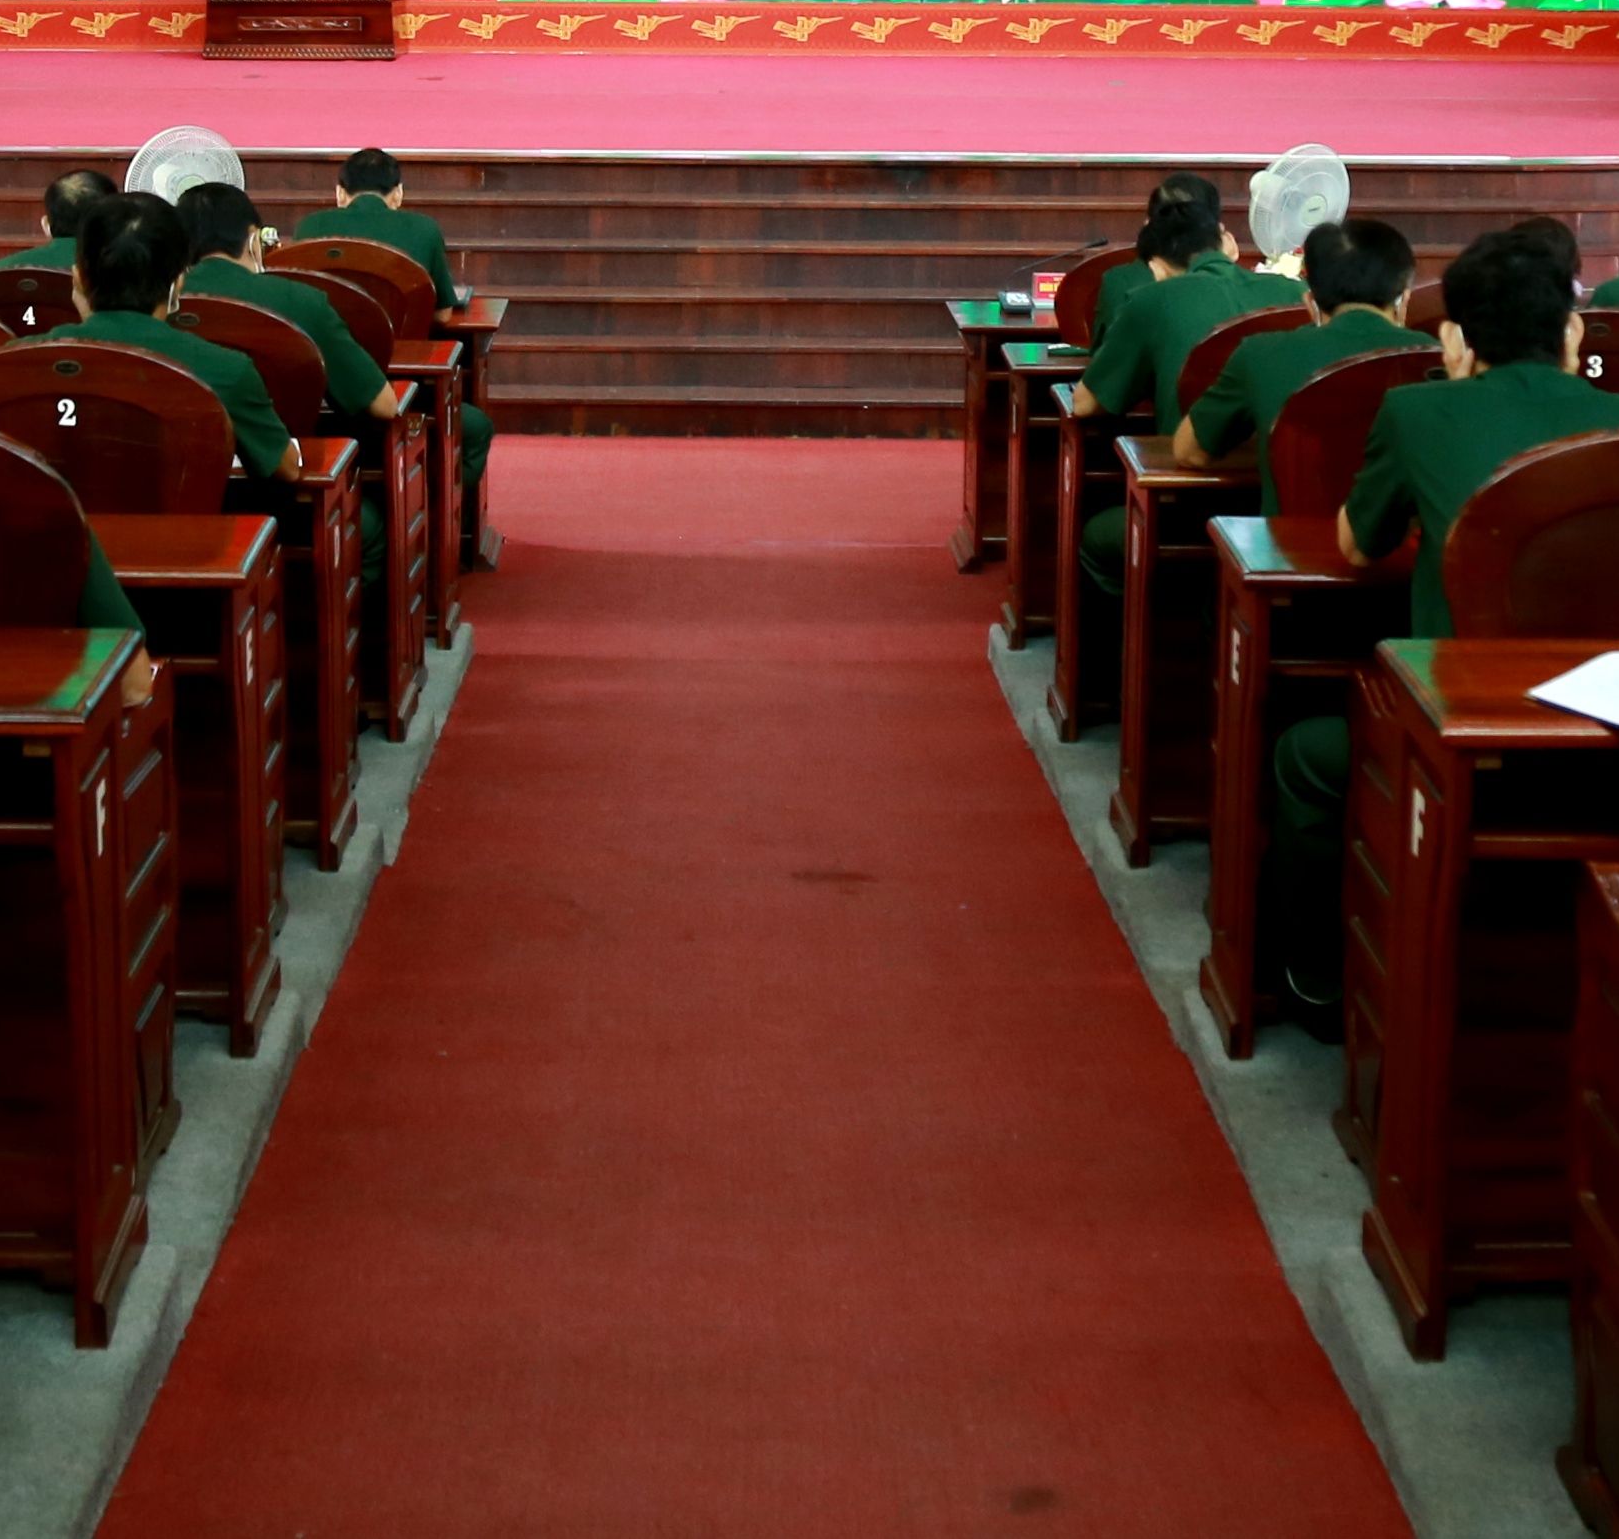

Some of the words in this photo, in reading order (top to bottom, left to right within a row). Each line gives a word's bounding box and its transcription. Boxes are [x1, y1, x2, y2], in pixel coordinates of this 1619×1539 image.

[23, 306, 35, 325] 4
[1586, 355, 1603, 377] 3
[58, 399, 76, 426] 2
[96, 779, 106, 856] F
[1412, 789, 1425, 855] F
